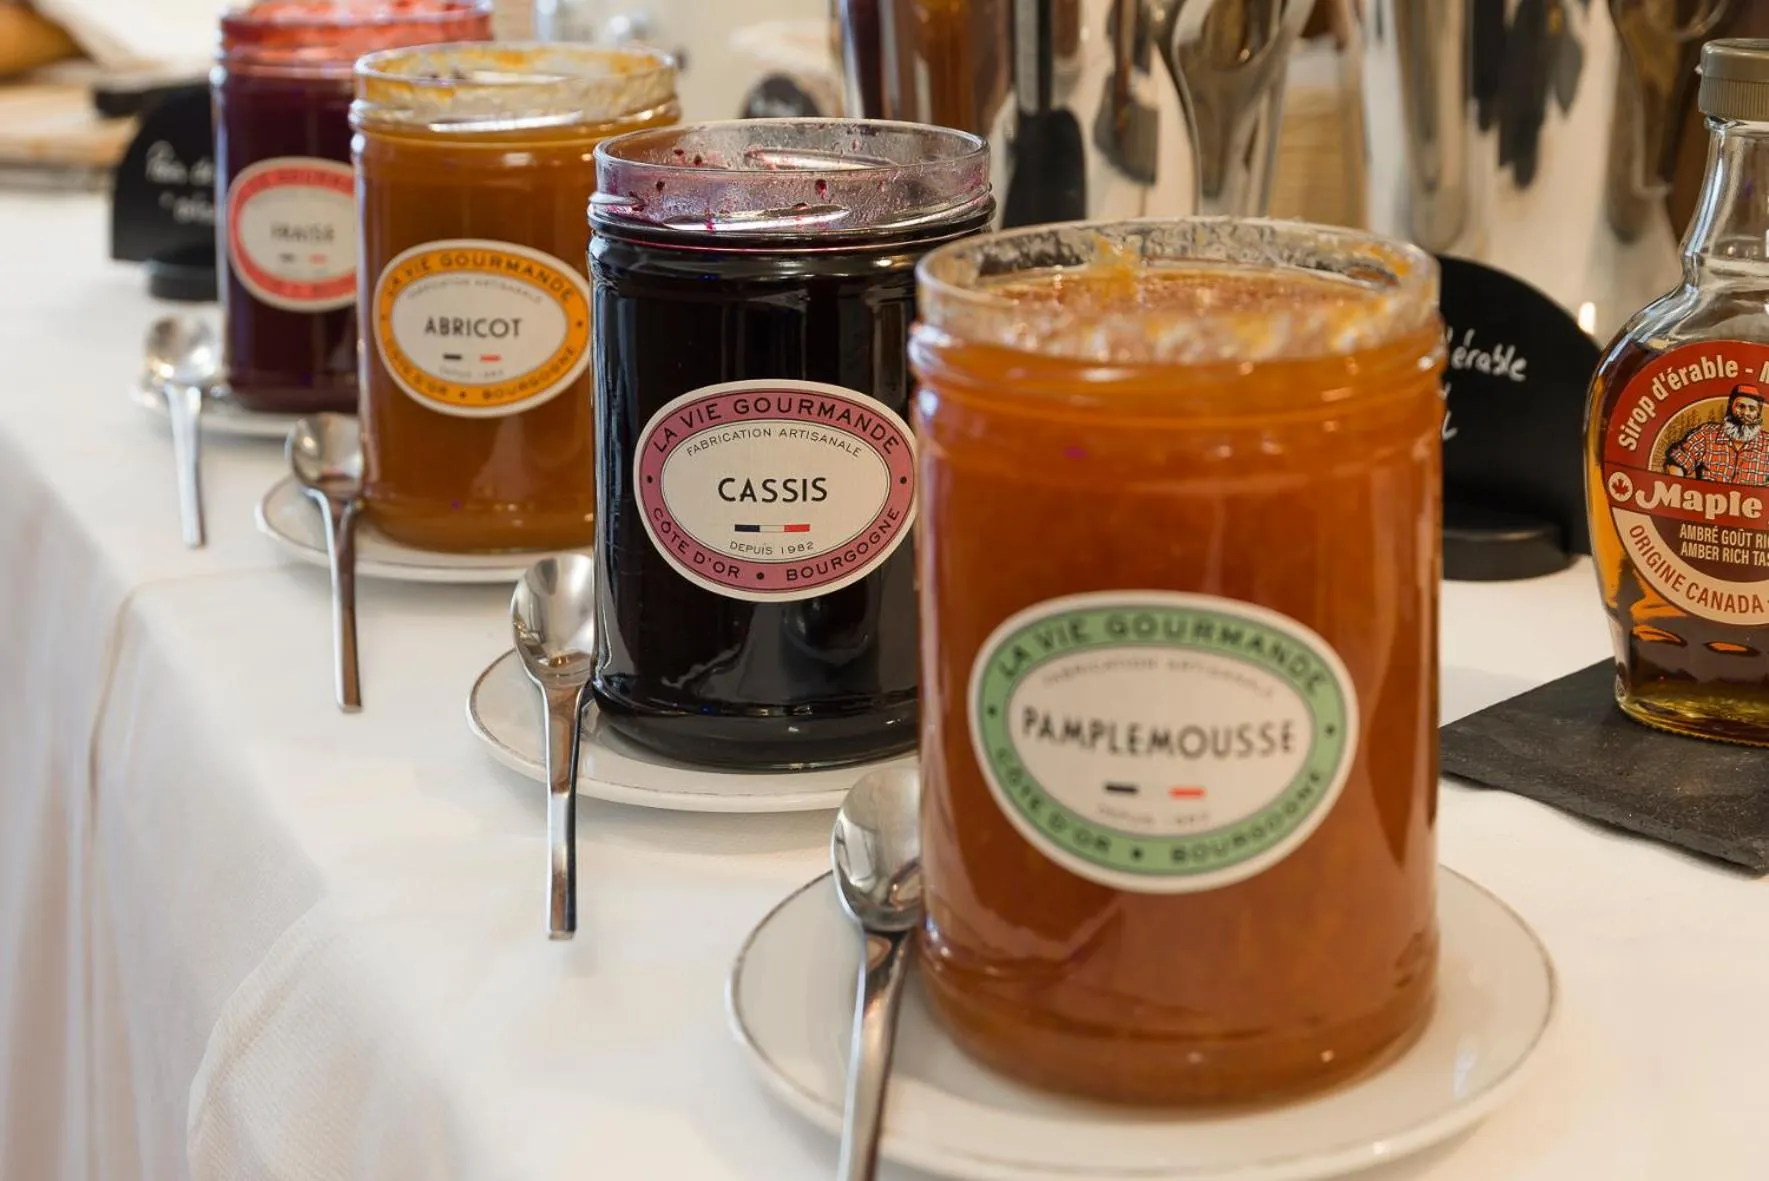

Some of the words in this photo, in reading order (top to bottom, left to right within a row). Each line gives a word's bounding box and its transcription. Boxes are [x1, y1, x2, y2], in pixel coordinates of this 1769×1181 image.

[440, 253, 574, 301] GOURMANDE
[425, 316, 522, 338] ABRICOT
[1618, 394, 1656, 451] Sirop
[1652, 354, 1738, 400] d'érable
[653, 428, 677, 453] LA
[680, 403, 721, 428] VIE
[733, 397, 899, 455] GOURMANDE
[686, 428, 772, 457] FABRICATION
[779, 428, 862, 458] ARTISANALE
[718, 477, 828, 503] CASSIS
[1635, 480, 1763, 520] Maple
[653, 507, 687, 554] CÔTE
[693, 551, 740, 579] D'OR
[786, 507, 900, 582] BOURGOGNE
[730, 540, 773, 556] DEPUIS
[781, 540, 814, 555] 1982
[1680, 523, 1718, 544] AMBRÉ
[1721, 528, 1753, 547] GOÛT
[1755, 533, 1769, 549] RI
[1681, 541, 1719, 561] AMBER
[1722, 547, 1749, 565] RICH
[1629, 524, 1686, 592] ORIGINE
[1686, 581, 1764, 614] CANADA
[999, 645, 1031, 680] LA
[1034, 617, 1090, 649] VIE
[1105, 614, 1325, 695] GOURMANDE
[1022, 705, 1294, 759] PAMPLEMOUSSE
